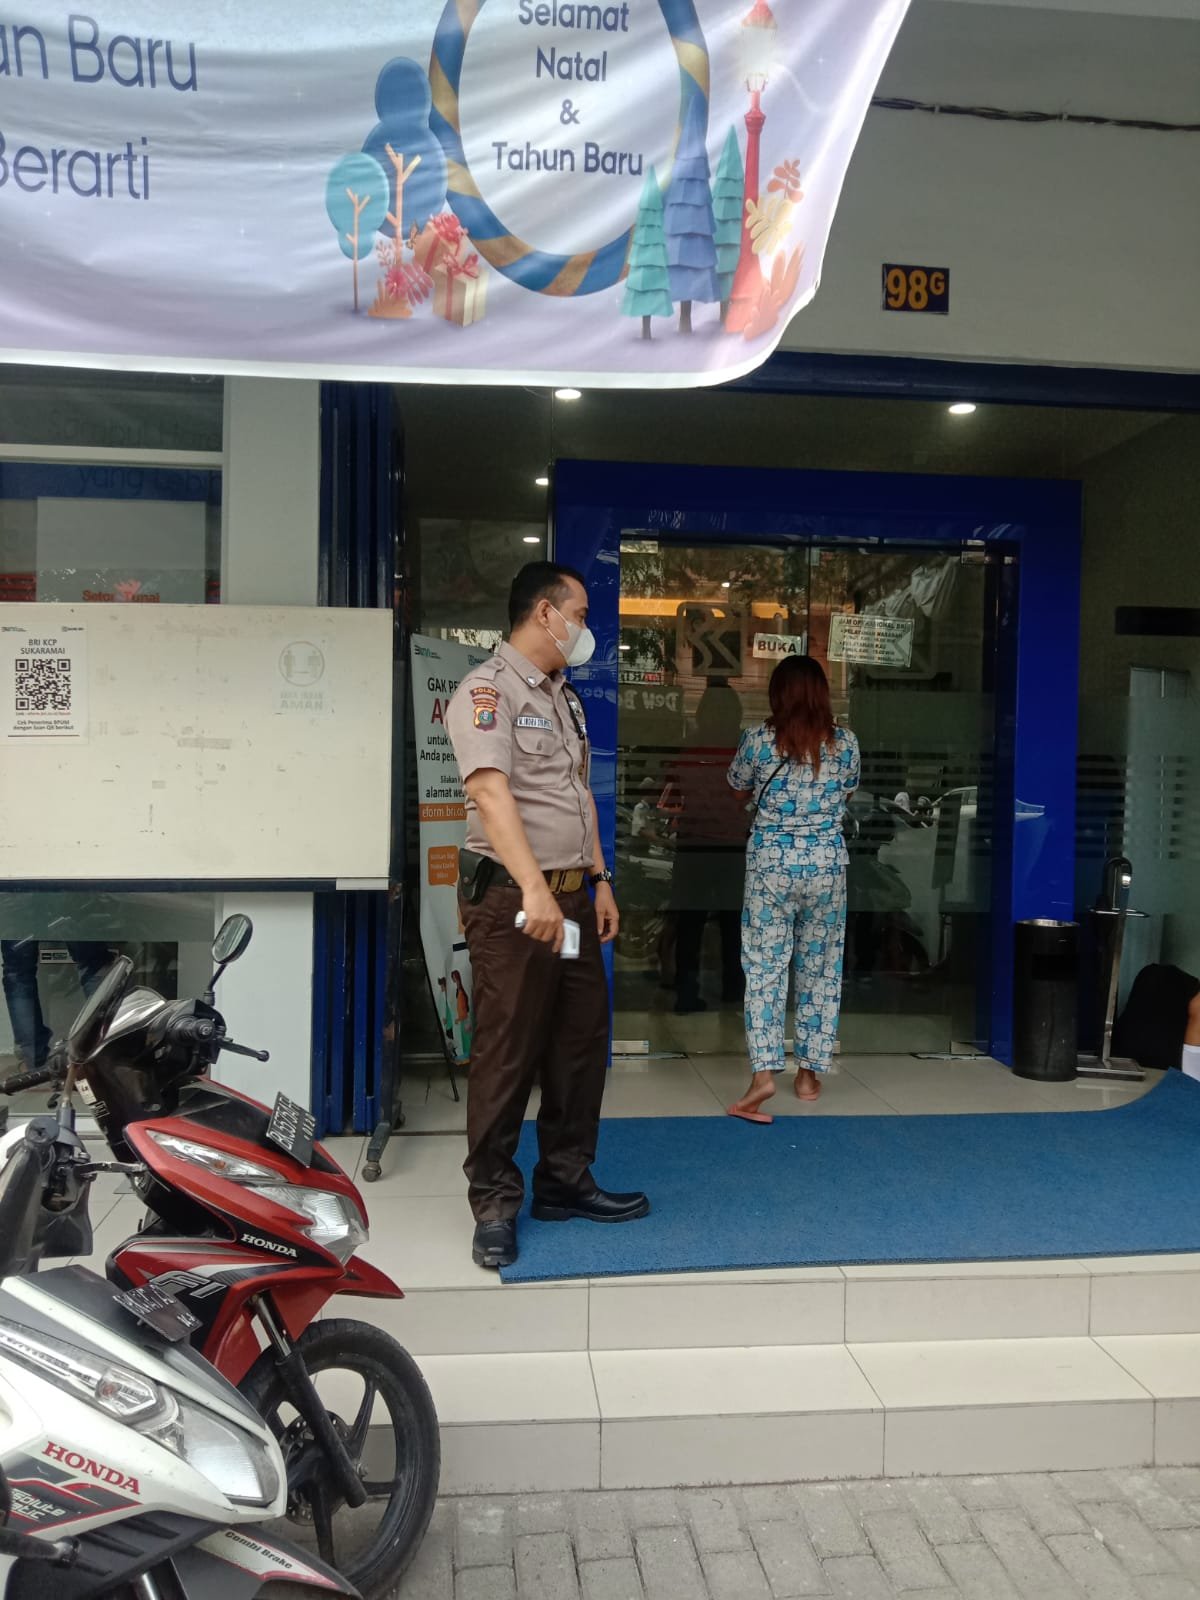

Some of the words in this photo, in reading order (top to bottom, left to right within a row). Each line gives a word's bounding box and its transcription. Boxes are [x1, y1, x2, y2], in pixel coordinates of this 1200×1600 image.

[518, 0, 630, 32] Selamat
[68, 14, 198, 92] Baru
[536, 46, 608, 82] Natal
[559, 98, 581, 125] &
[491, 141, 576, 172] Tahun
[584, 141, 643, 176] Baru
[20, 647, 66, 655] SUKARAMAI
[757, 640, 798, 653] BUKA
[427, 677, 447, 693] GAK
[427, 735, 449, 746] untuk
[420, 749, 441, 761] Anda
[425, 785, 452, 798] alamat
[241, 1233, 298, 1258] HONDA
[41, 1440, 141, 1495] HONDA
[11, 1488, 66, 1518] solute
[11, 1503, 46, 1520] atic
[224, 1530, 261, 1554] Combi
[259, 1547, 293, 1570] Brake
